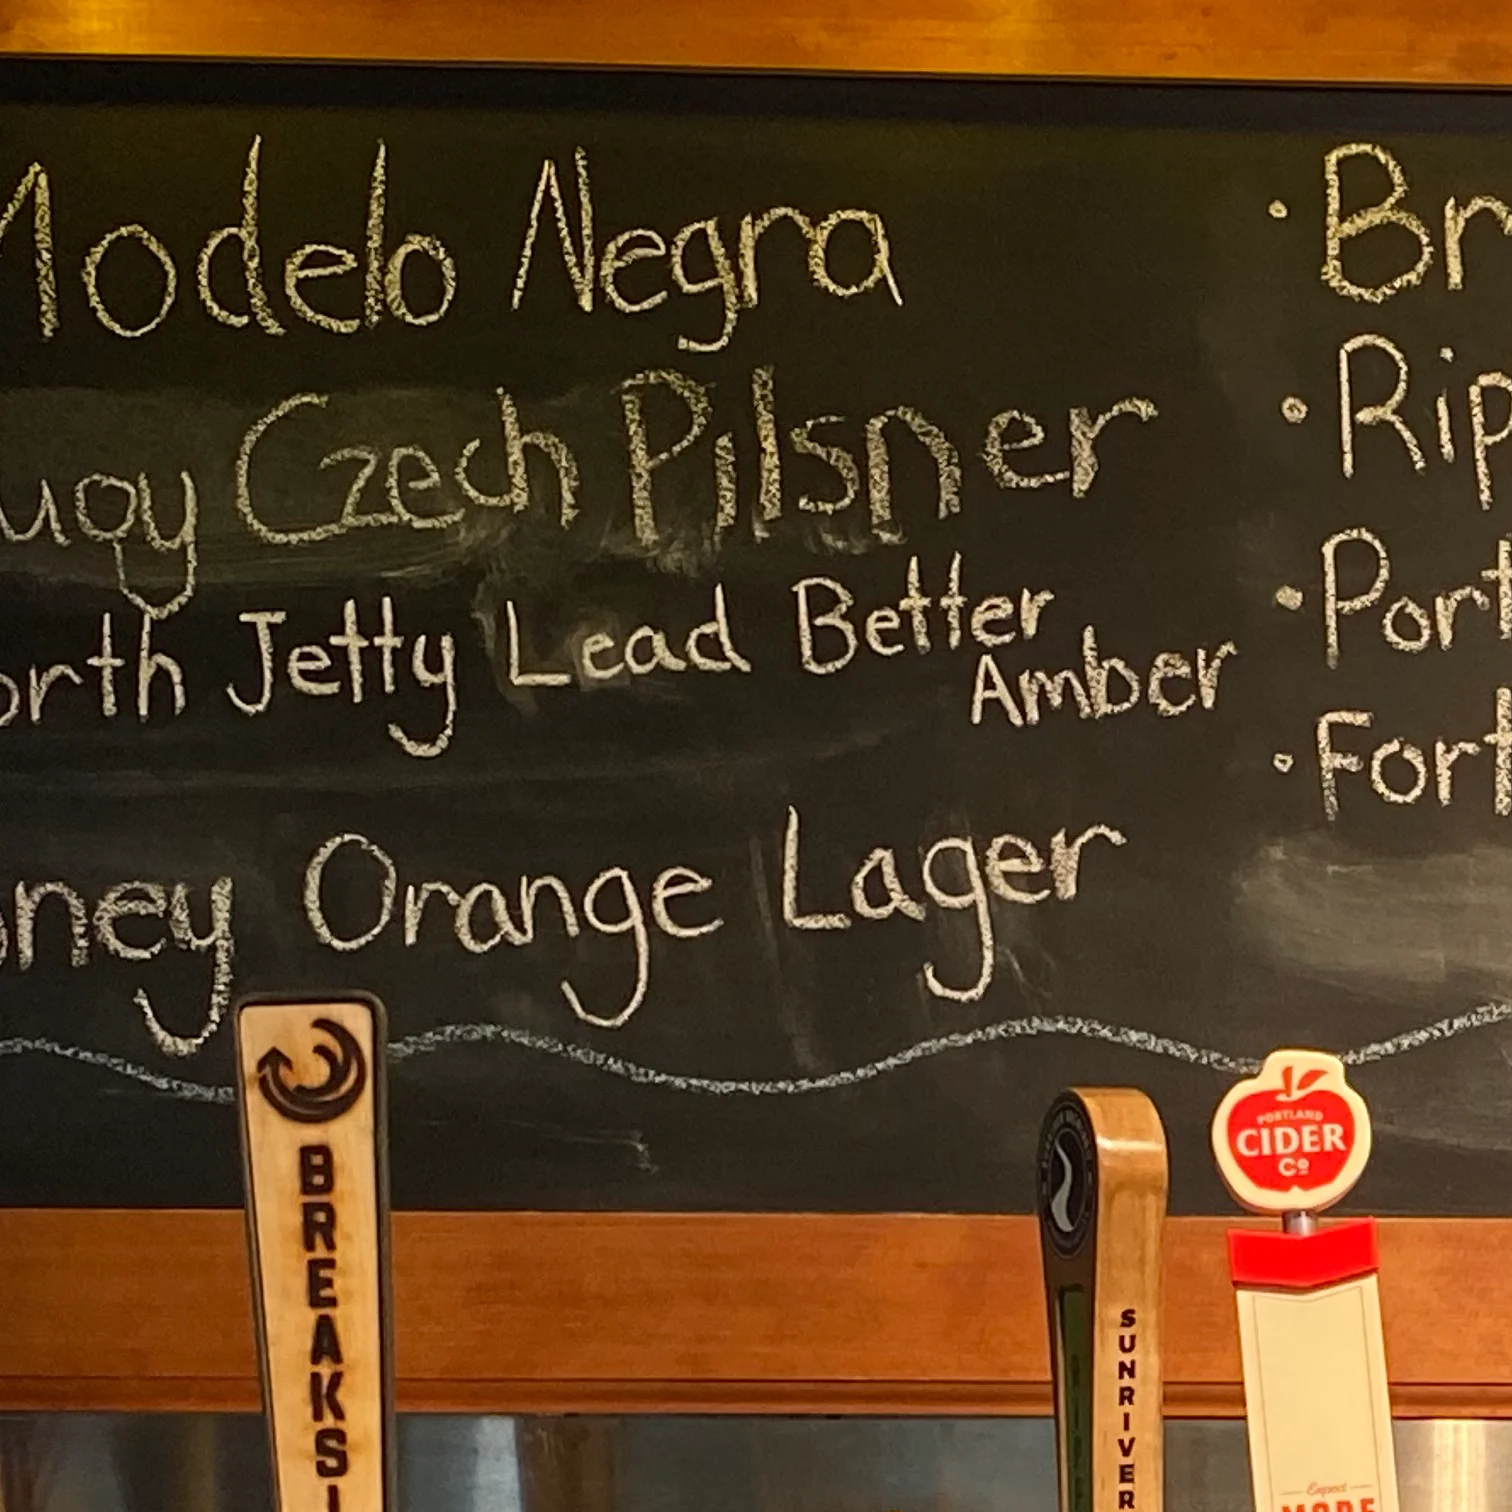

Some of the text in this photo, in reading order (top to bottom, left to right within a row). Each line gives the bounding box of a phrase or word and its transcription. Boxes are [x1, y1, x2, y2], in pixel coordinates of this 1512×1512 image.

[511, 145, 902, 351] Negra
[236, 387, 580, 546] Czech
[618, 364, 1159, 545] Pilsner
[226, 596, 456, 757] Jetty
[505, 582, 751, 689] Lead
[792, 551, 1055, 676] Better
[972, 625, 1238, 727] Amber
[305, 833, 724, 1030] Orange
[782, 803, 1128, 1002] Lager
[1237, 1123, 1346, 1157] CIDER
[1257, 1109, 1323, 1124] PORTLAND
[1117, 1308, 1137, 1511] SUNRIVER
